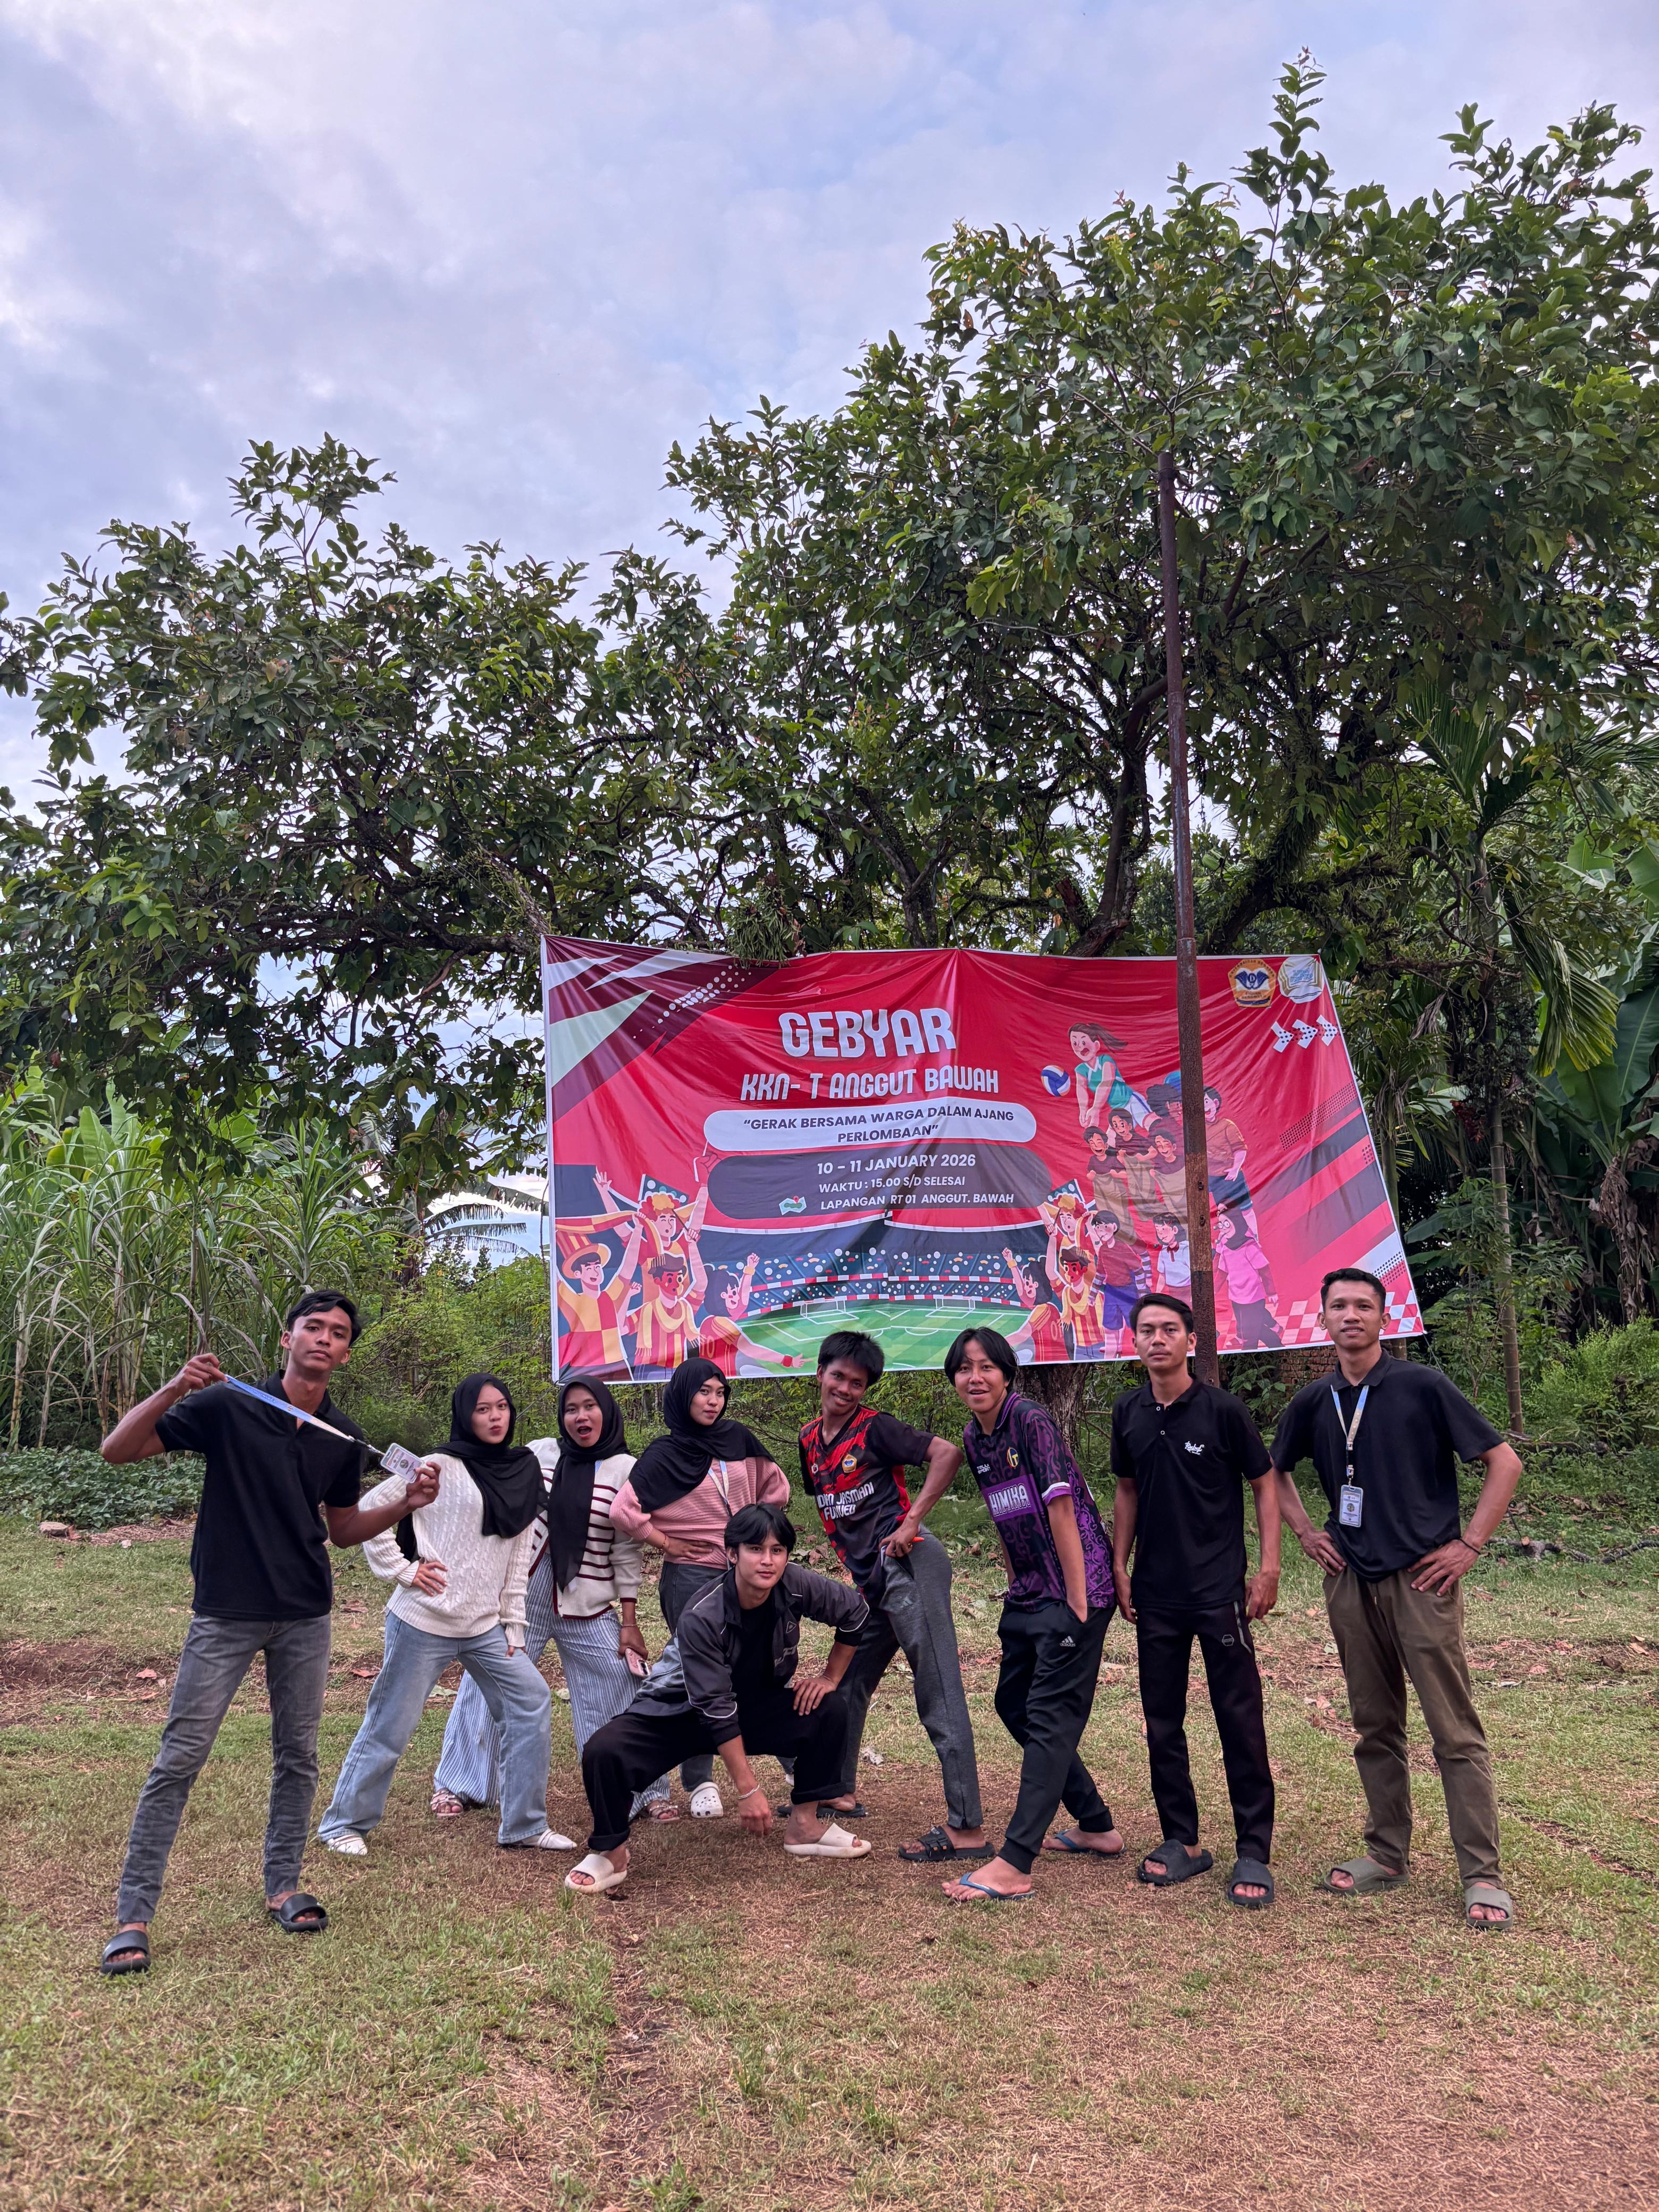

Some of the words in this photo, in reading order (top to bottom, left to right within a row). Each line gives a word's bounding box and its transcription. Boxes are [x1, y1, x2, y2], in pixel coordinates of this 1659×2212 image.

[778, 1007, 957, 1058] GEBYAR
[740, 1073, 801, 1101] KKN-
[810, 1073, 824, 1099] T
[829, 1069, 917, 1099] ANGGUT
[925, 1065, 999, 1093] BAWAH
[744, 1119, 797, 1129] “GERAK
[801, 1115, 867, 1128] BERSAMA
[870, 1109, 924, 1123] WARGA
[927, 1105, 972, 1118] DALAM
[974, 1108, 1014, 1121] AJANG
[838, 1124, 939, 1143] PERLOMBAAN”
[817, 1162, 833, 1175] 10
[850, 1160, 861, 1172] 11
[865, 1155, 939, 1171] JANUARY
[941, 1154, 976, 1167] 2026
[819, 1181, 862, 1193] WAKTU
[870, 1177, 901, 1188] 15.00
[903, 1174, 921, 1188] S/D
[924, 1176, 965, 1186] SELESAI
[820, 1195, 885, 1210] LAPANGAN
[890, 1194, 904, 1204] RT
[905, 1194, 916, 1204] 01
[920, 1194, 970, 1204] ANGGUT.
[973, 1193, 1014, 1203] BAWAH
[836, 1481, 875, 1505] JASMANI
